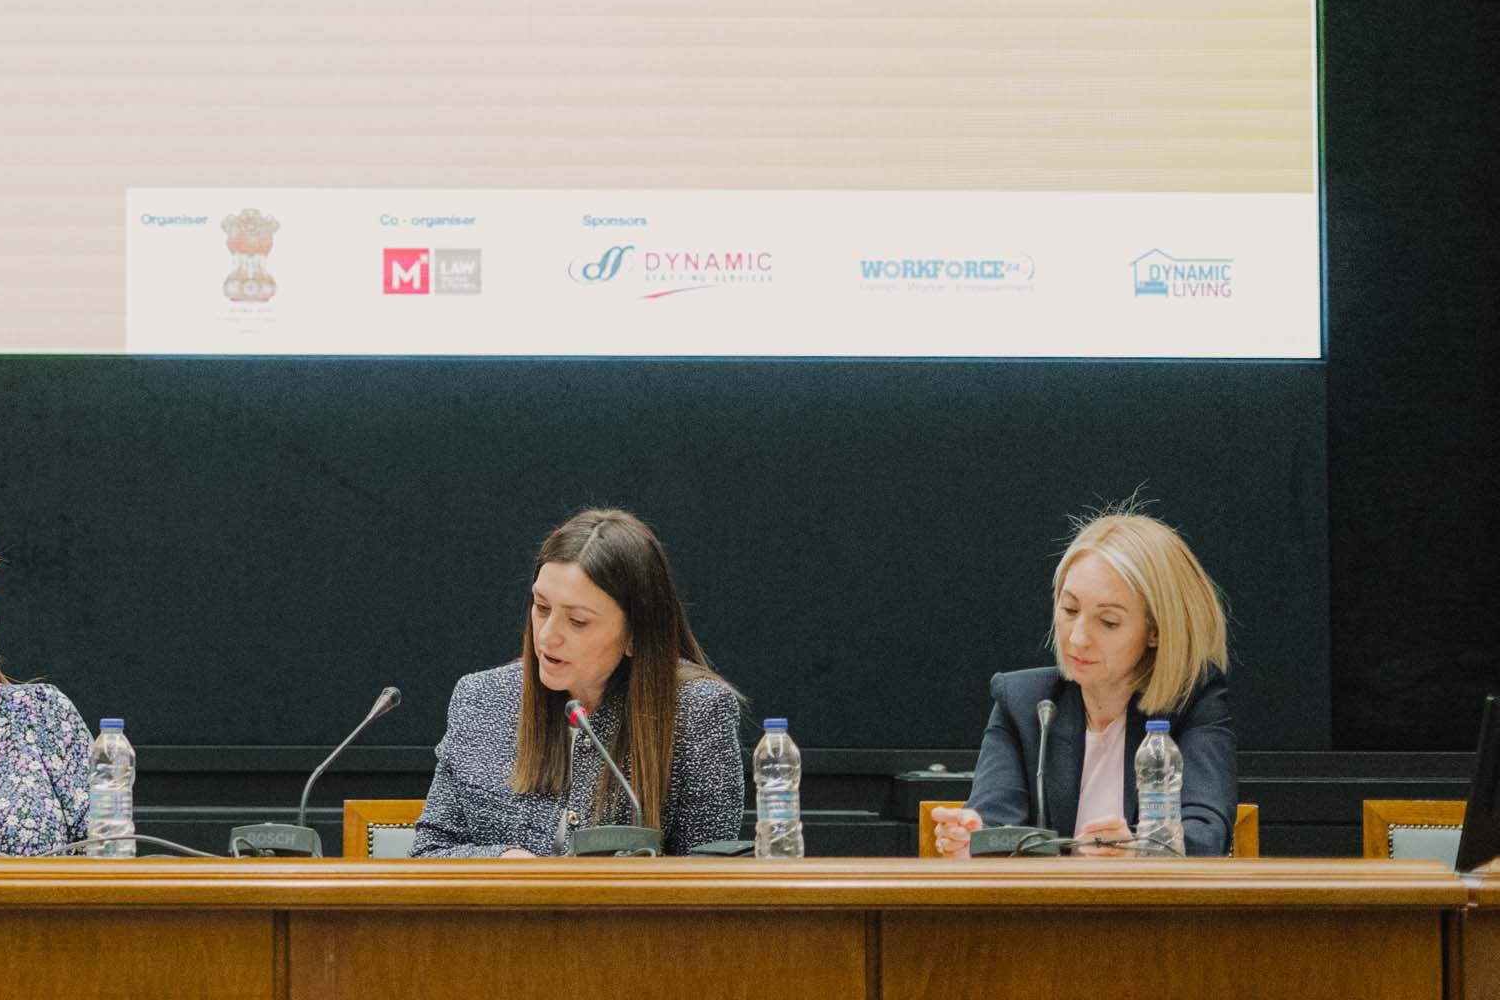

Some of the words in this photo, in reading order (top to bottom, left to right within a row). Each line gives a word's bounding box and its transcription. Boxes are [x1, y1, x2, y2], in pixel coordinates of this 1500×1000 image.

[140, 213, 208, 227] Organiser
[583, 214, 648, 227] Sponsors
[644, 251, 773, 272] DYNAMIC
[859, 260, 1006, 280] WORKFORCE
[1148, 263, 1232, 281] DYNAMIC
[1172, 281, 1233, 298] LIVING
